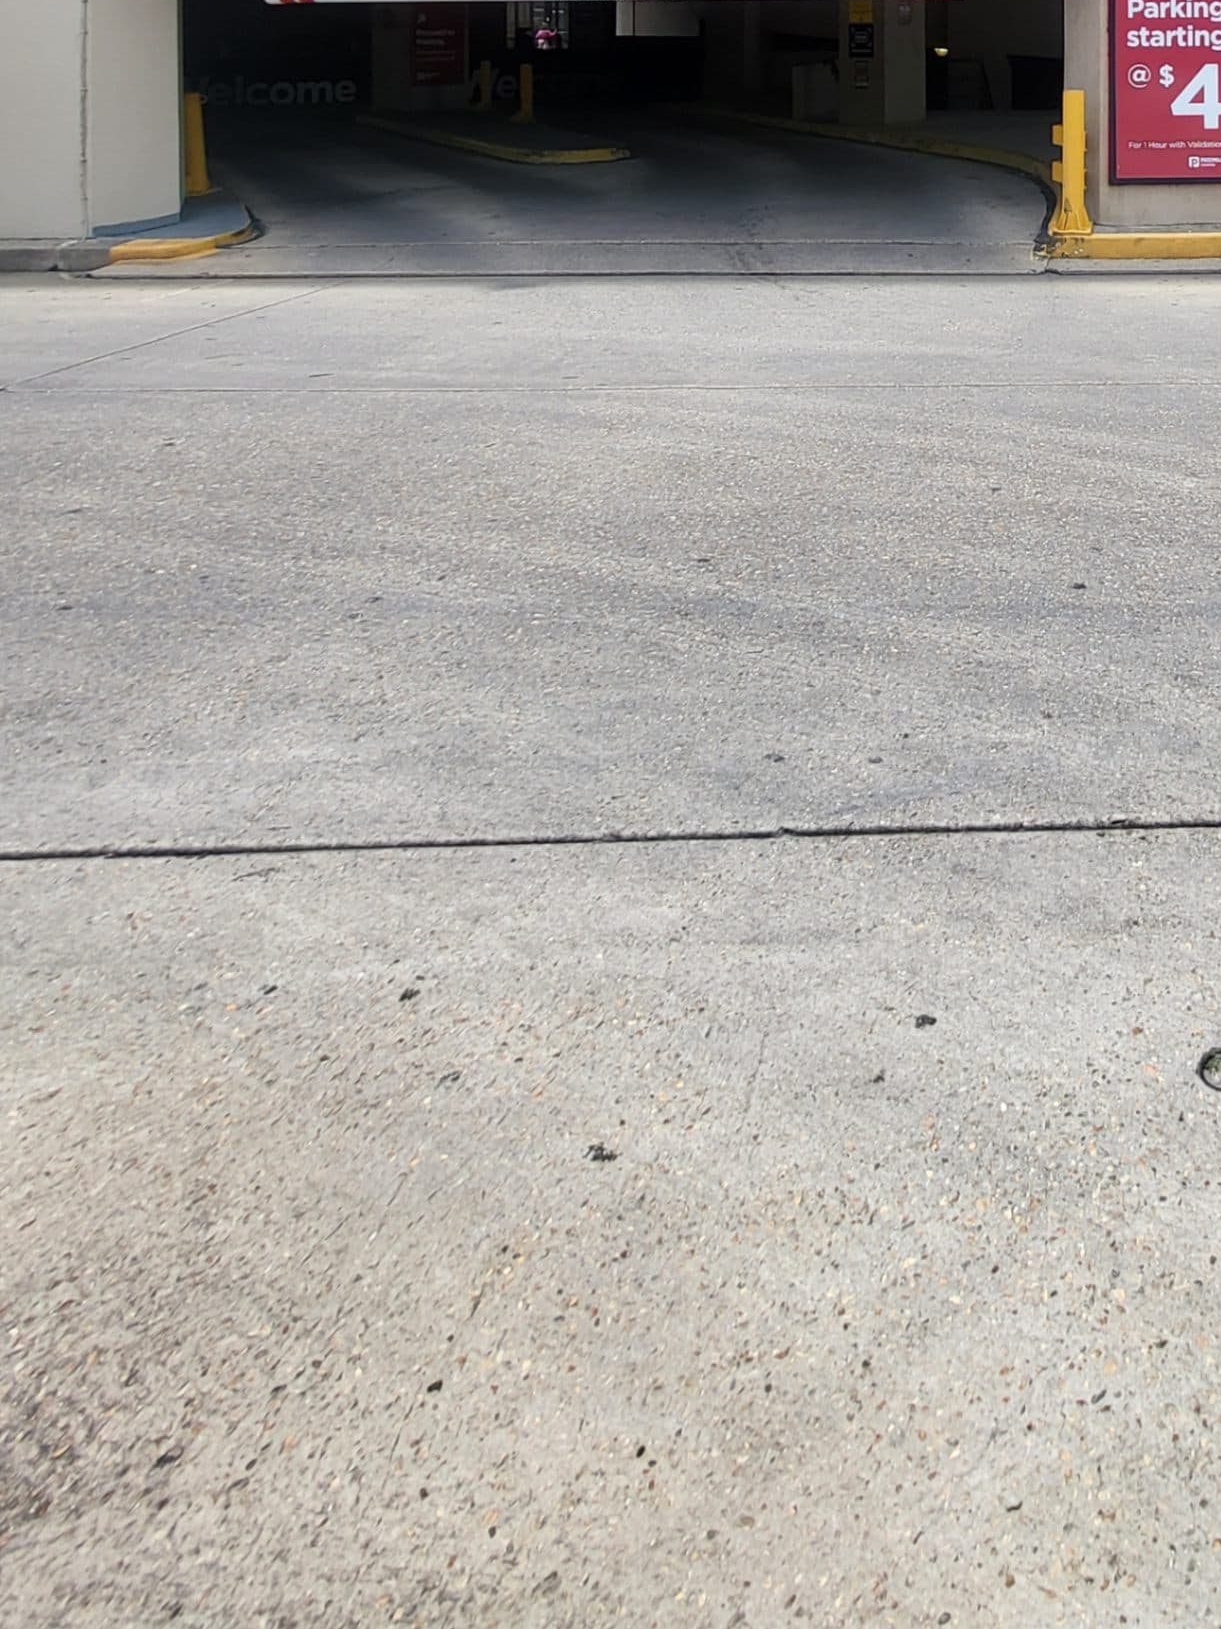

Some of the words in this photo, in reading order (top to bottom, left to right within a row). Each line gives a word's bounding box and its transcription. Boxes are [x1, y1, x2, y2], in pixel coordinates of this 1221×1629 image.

[1127, 64, 1152, 89] @
[1128, 141, 1142, 149] For
[1148, 141, 1168, 149] Hour
